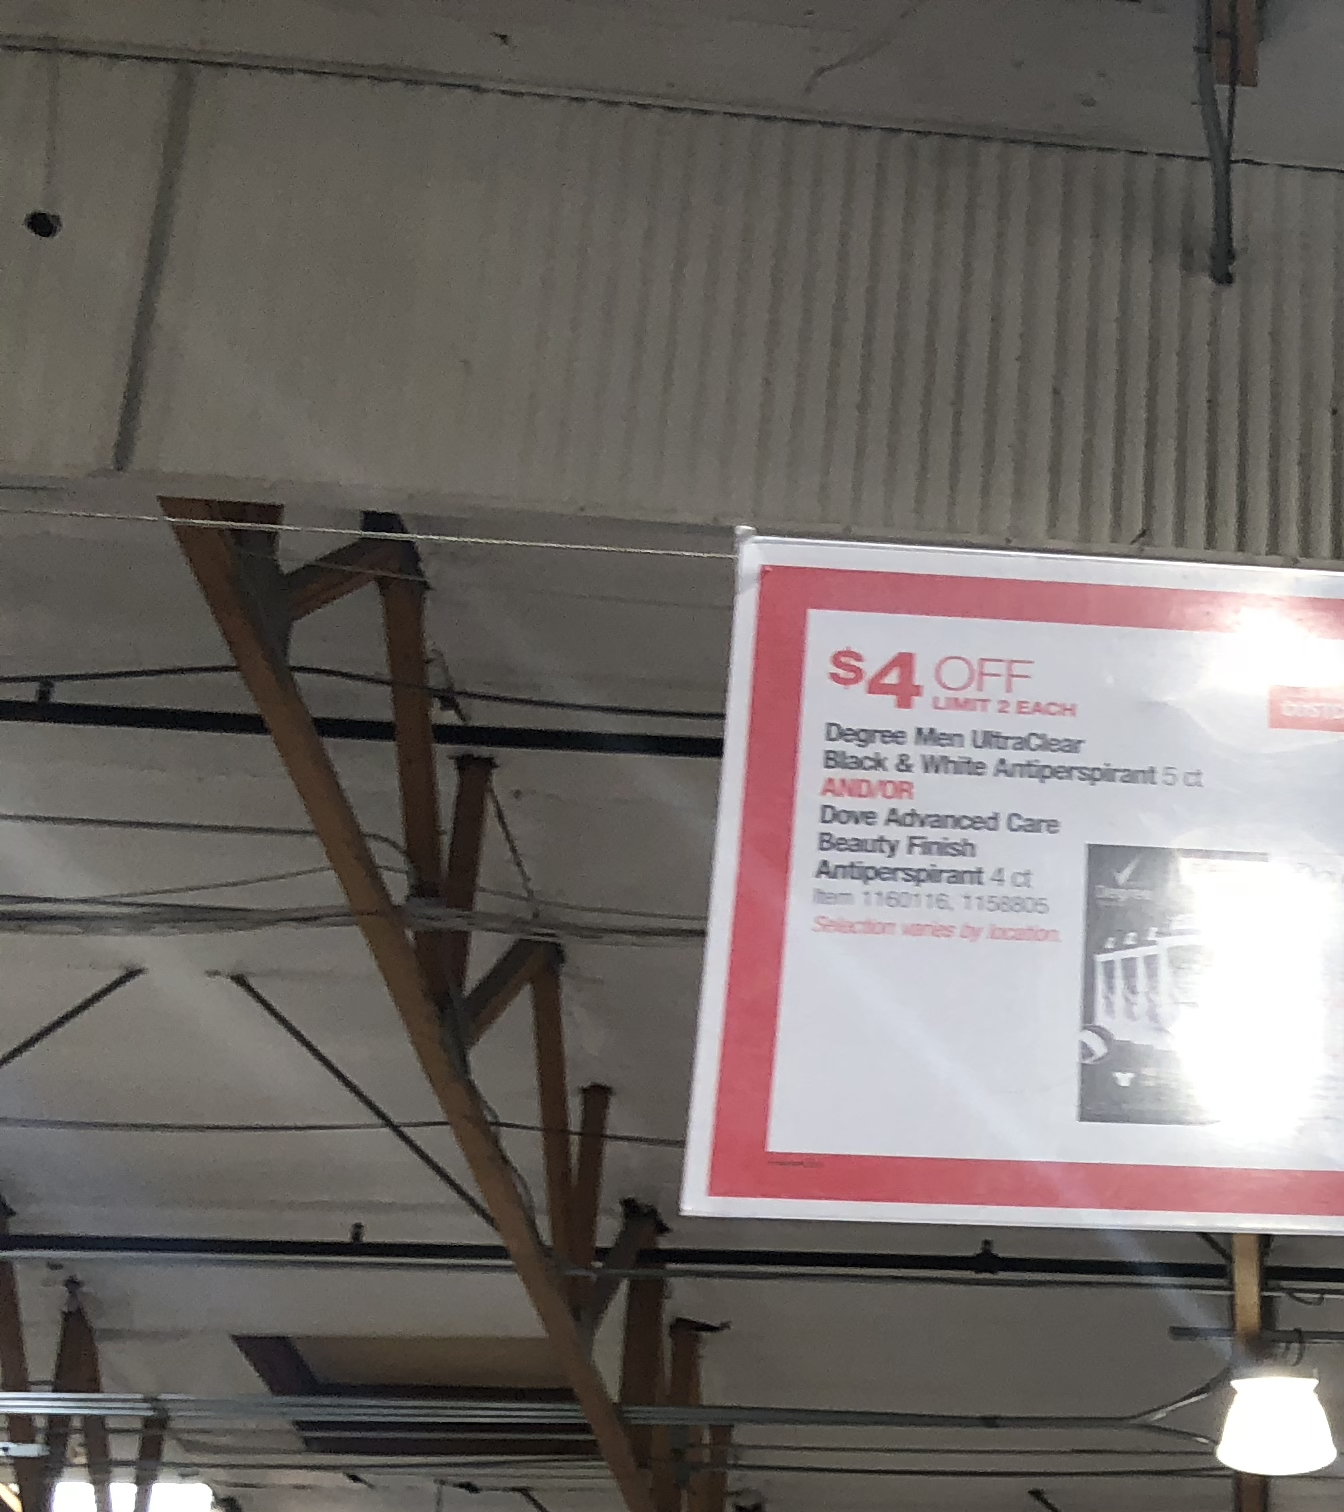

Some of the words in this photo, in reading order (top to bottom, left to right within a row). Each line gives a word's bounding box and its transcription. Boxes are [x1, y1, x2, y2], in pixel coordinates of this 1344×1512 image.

[828, 647, 924, 710] $4
[934, 655, 1035, 693] OFF
[931, 696, 990, 712] LIMIT
[996, 698, 1011, 714] 2
[1016, 701, 1077, 717] EACH
[824, 722, 907, 747] Degree
[914, 726, 965, 748] Men
[971, 729, 1086, 753] UltraClear
[822, 750, 888, 773] Black
[895, 754, 914, 773] &
[920, 754, 987, 777] White
[993, 758, 1159, 786] Antiperspirant
[1162, 767, 1178, 785] 5
[1182, 770, 1204, 788] ct
[820, 777, 915, 800] AND/OR
[820, 804, 878, 826] Dove
[884, 807, 1001, 832] Advanced
[1005, 812, 1061, 834] Care
[818, 832, 900, 858] Beauty
[906, 836, 977, 858] Finish
[815, 859, 985, 887] Antiperspirant
[989, 867, 1005, 887] 4
[1011, 869, 1033, 889] ct
